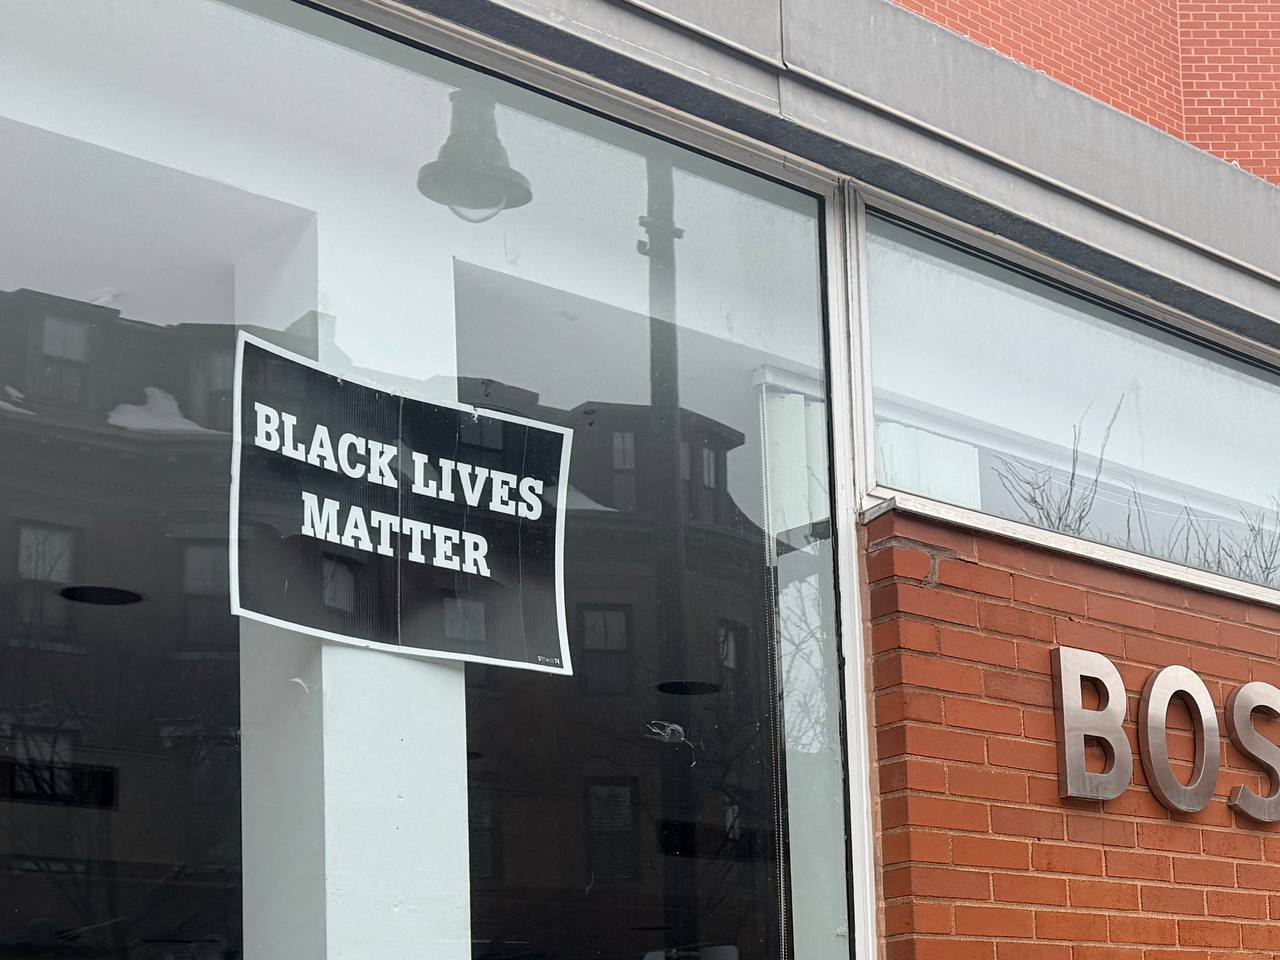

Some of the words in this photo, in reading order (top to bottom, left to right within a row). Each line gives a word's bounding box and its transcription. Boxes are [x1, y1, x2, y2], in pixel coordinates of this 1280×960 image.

[254, 401, 398, 488] BLACK
[411, 451, 544, 521] LIVES
[301, 491, 491, 578] MATTER
